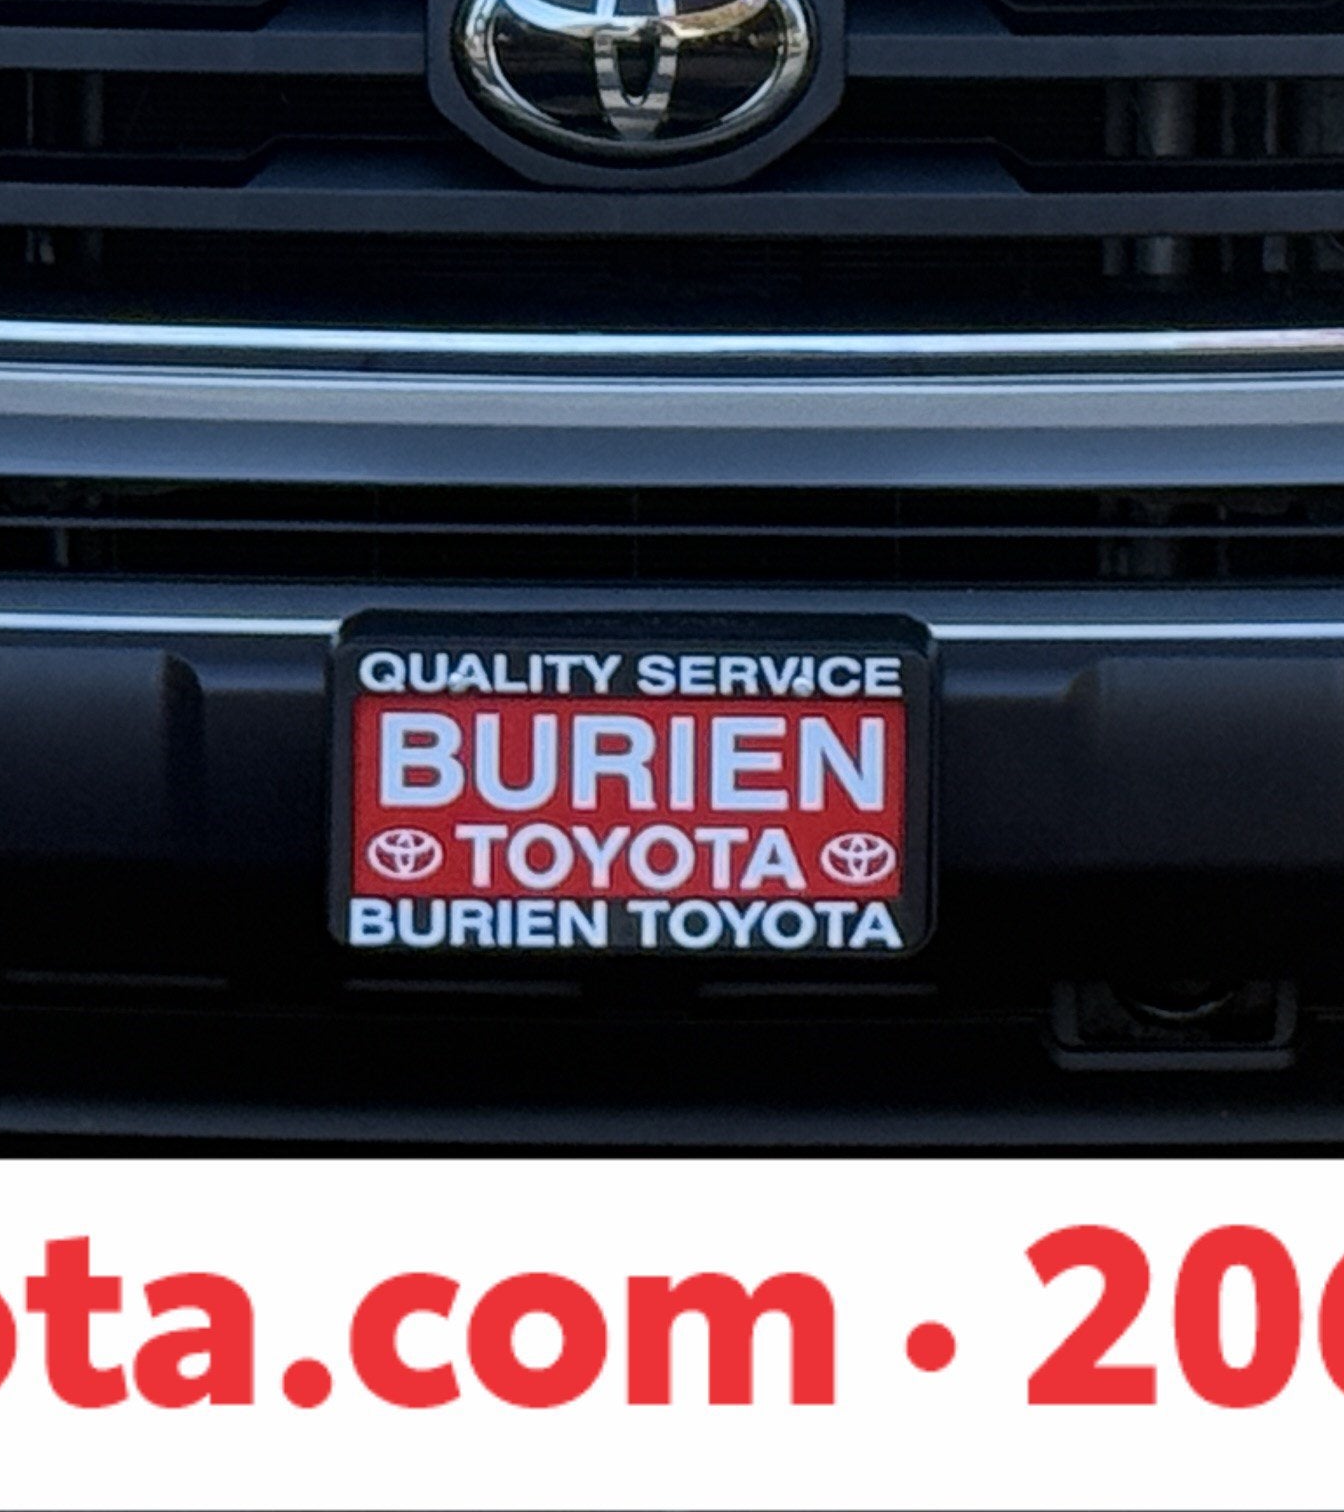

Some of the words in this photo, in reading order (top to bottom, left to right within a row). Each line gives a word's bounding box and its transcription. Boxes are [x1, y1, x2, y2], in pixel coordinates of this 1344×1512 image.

[358, 651, 622, 693] QUALITY
[637, 654, 902, 696] SERVICE
[378, 711, 887, 812] BURIEN
[454, 822, 807, 891] TOYOTA
[349, 897, 608, 948] BURIEN
[626, 899, 903, 949] TOYOTA
